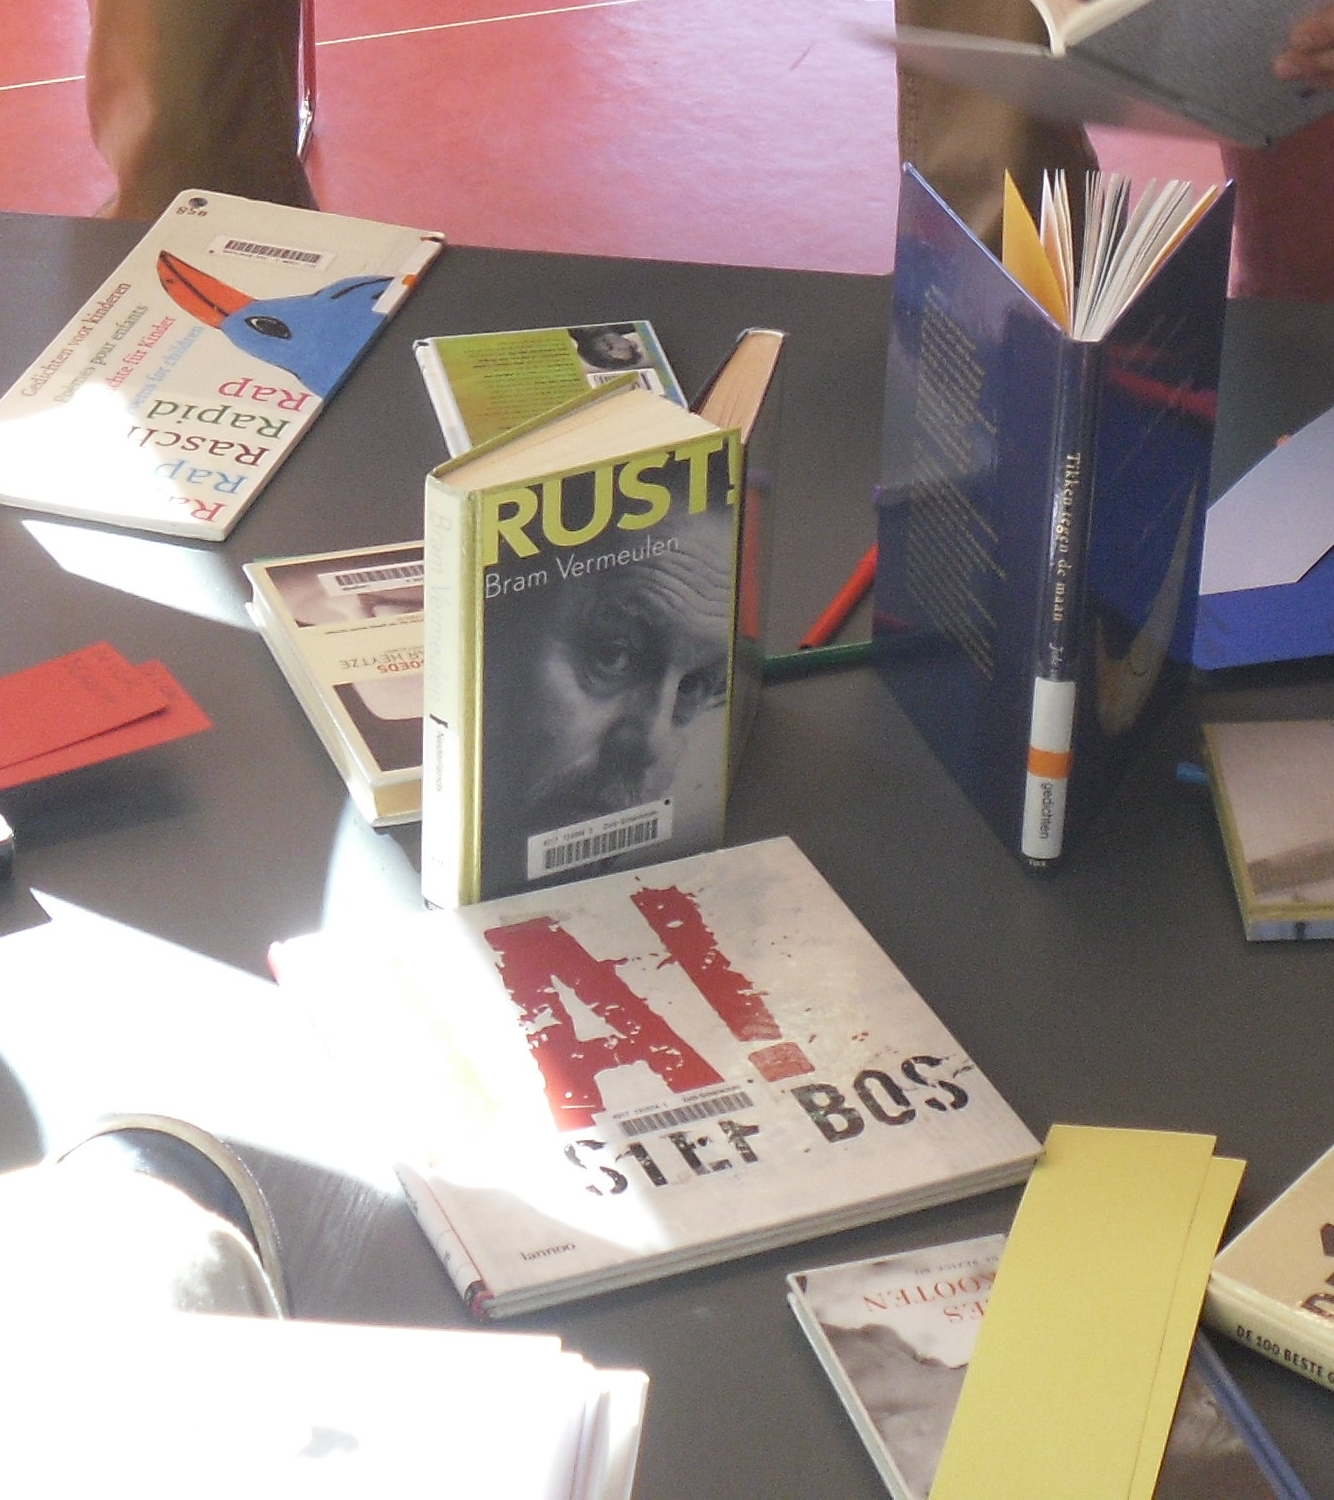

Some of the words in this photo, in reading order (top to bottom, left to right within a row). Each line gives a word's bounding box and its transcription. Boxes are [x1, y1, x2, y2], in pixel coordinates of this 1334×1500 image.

[20, 346, 73, 396] Gedichten
[68, 322, 92, 347] voor
[88, 283, 131, 324] kinderen
[90, 338, 114, 366] pour
[112, 305, 149, 340] enfants
[123, 347, 145, 366] für
[142, 315, 177, 348] Kinder
[169, 325, 204, 365] children
[217, 378, 310, 411] Rap
[148, 398, 289, 441] Rapid
[127, 425, 270, 468] Rasch
[1062, 452, 1080, 505] Tikken
[483, 437, 741, 565] RUST!
[1054, 511, 1074, 553] tegen
[484, 568, 548, 600] Bram
[556, 534, 679, 579] Vermeulen
[1057, 559, 1071, 576] de
[1053, 582, 1067, 622] maan
[339, 652, 402, 669] HEYTZE
[376, 659, 424, 674] OEDS
[1036, 782, 1055, 839] gedichten
[791, 1053, 975, 1145] BOS
[519, 1243, 577, 1262] lannoo
[1235, 1324, 1251, 1341] DE
[1255, 1335, 1280, 1356] 100
[1283, 1347, 1323, 1377] BESTE
